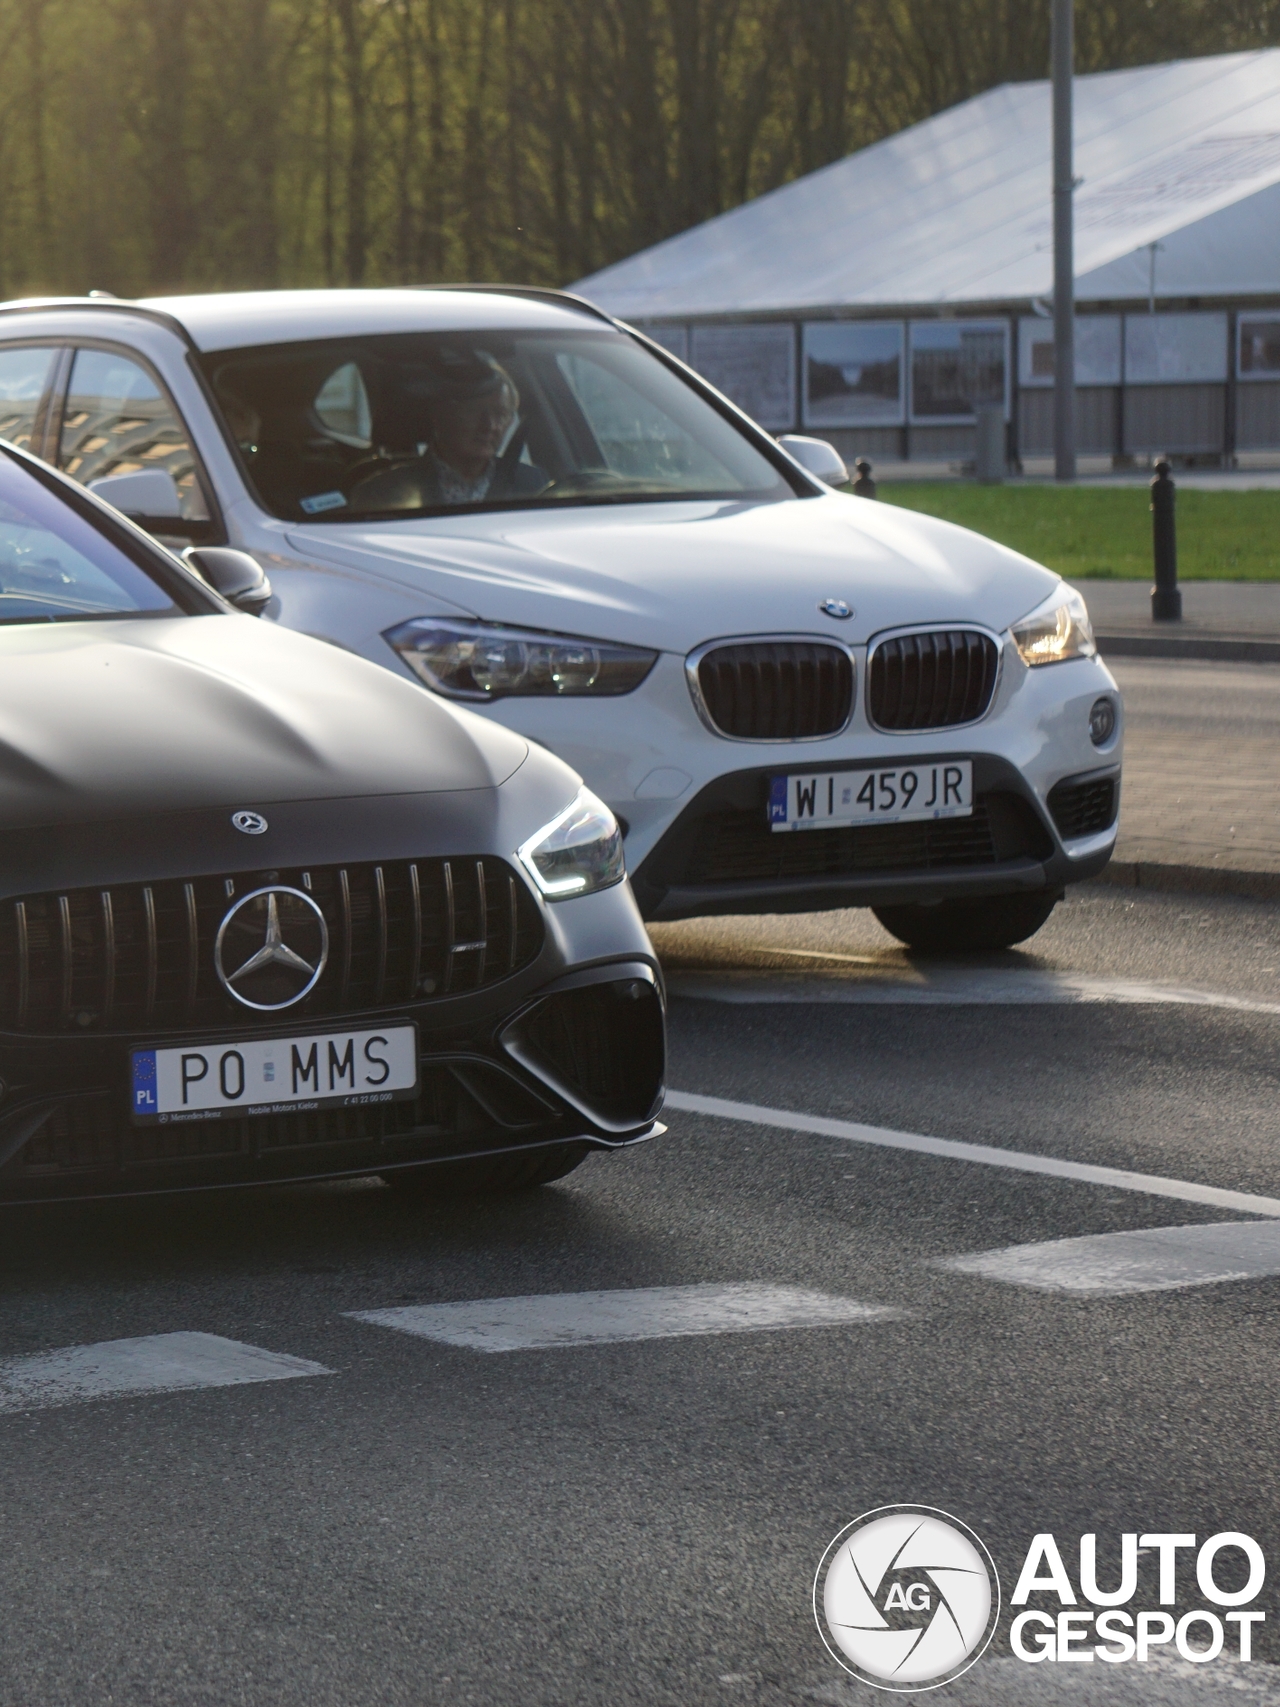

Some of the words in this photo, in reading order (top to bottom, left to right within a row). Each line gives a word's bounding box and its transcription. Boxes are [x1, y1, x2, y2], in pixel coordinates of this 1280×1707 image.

[796, 777, 834, 818] WI
[772, 806, 785, 817] PL
[291, 1036, 390, 1094] MMS
[137, 1090, 155, 1104] PL
[248, 1105, 271, 1115] Nobile
[272, 1103, 296, 1112] Motors
[297, 1101, 319, 1110] Kielce
[170, 1110, 222, 1121] Mercedes-Benz
